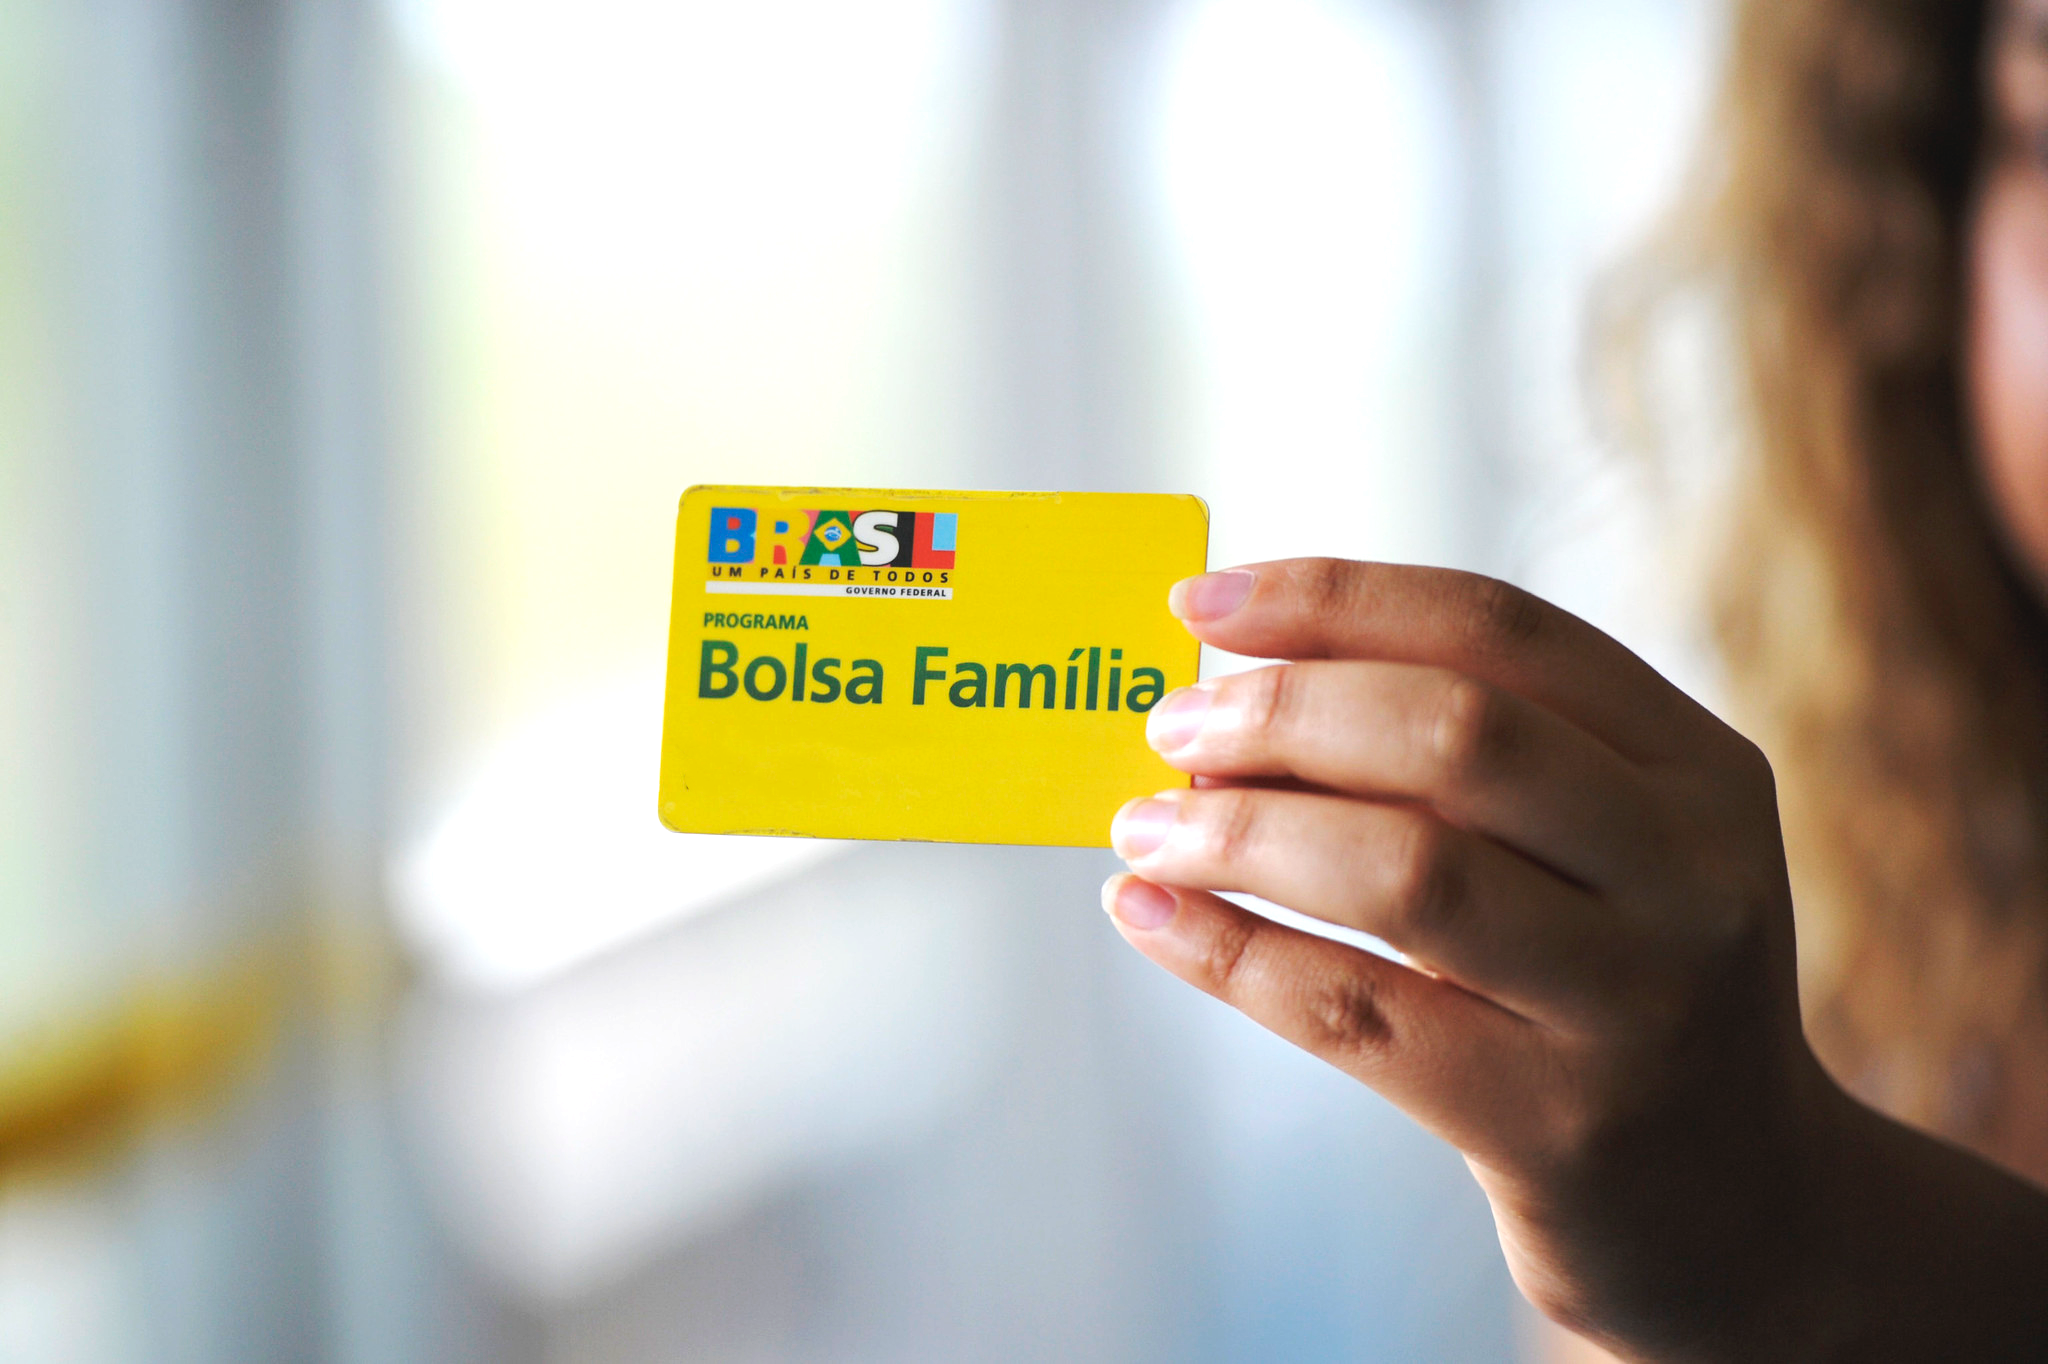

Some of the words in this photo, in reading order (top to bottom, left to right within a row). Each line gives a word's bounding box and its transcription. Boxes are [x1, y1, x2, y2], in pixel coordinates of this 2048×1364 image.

[707, 507, 957, 569] BRASIL
[712, 566, 742, 578] UM
[760, 565, 813, 581] PAÍS
[829, 568, 855, 582] DE
[873, 569, 949, 584] TODOS
[845, 586, 898, 596] GOVERNO
[900, 587, 947, 598] FEDERAL
[703, 612, 809, 631] PROGRAMA
[698, 638, 884, 705] Bolsa
[912, 646, 1166, 713] Família
